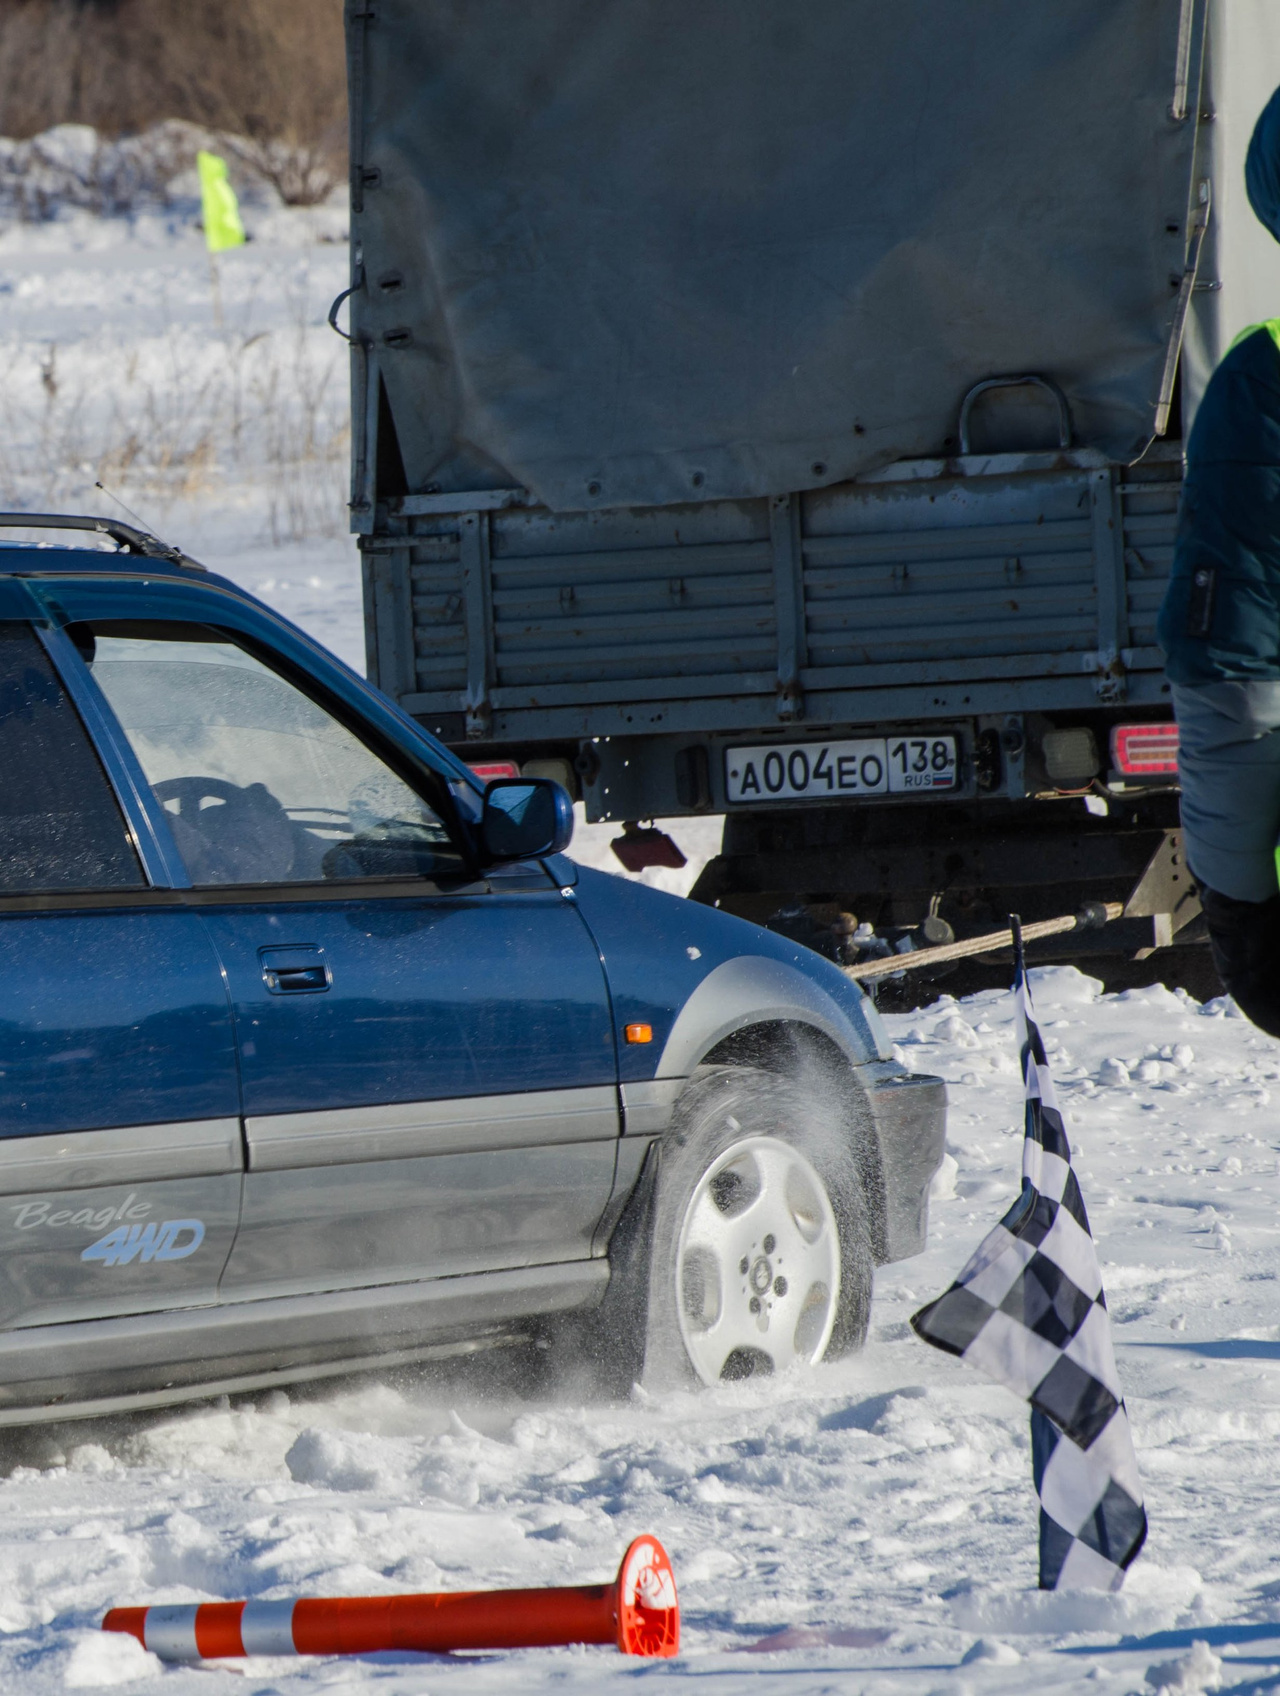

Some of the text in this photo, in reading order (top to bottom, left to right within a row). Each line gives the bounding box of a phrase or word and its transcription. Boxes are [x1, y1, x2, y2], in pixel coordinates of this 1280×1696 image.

[891, 740, 949, 774] 138
[905, 775, 932, 788] RUS
[9, 1192, 153, 1231] Beagle
[80, 1217, 206, 1267] 4WD
